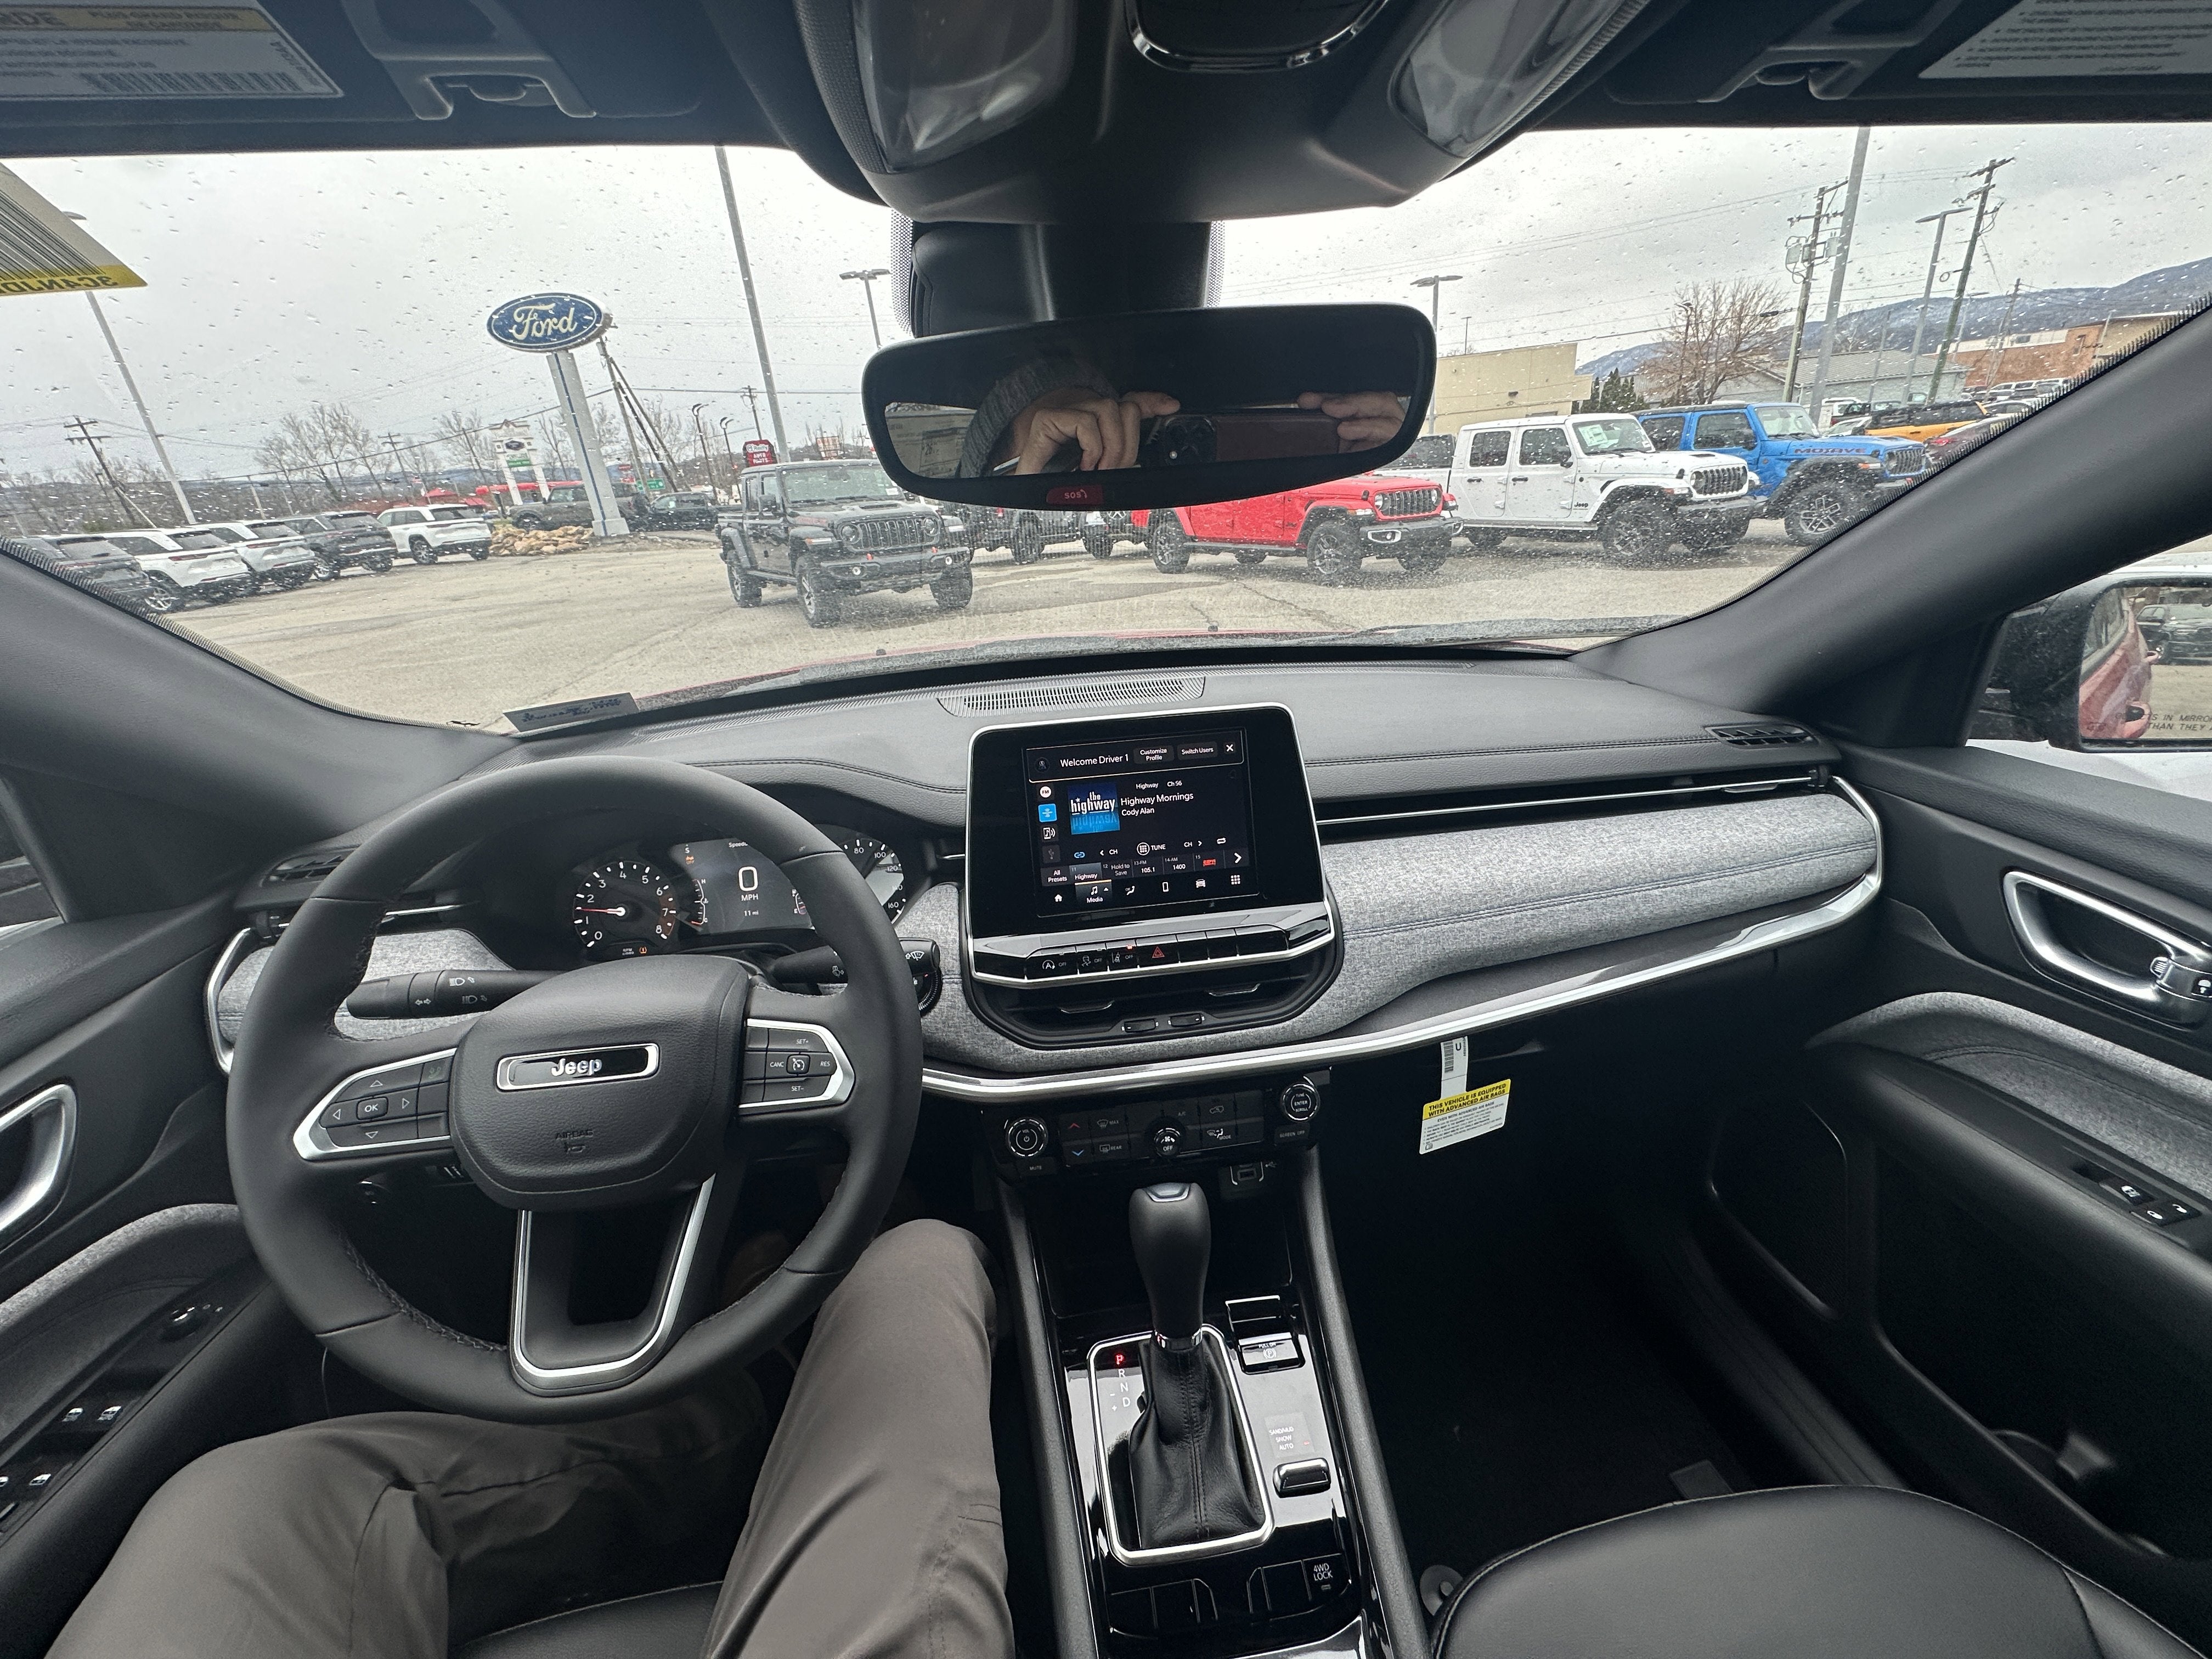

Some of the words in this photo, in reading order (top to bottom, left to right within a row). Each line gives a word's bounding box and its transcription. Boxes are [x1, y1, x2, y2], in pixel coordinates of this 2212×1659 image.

[512, 303, 578, 340] Ford
[2149, 722, 2174, 731] THAN
[2180, 723, 2206, 731] THEY
[1060, 757, 1098, 768] Welcome
[1098, 755, 1123, 765] Driver
[1125, 754, 1129, 762] 1
[1136, 782, 1159, 790] Highway
[1089, 791, 1101, 801] the
[1120, 797, 1155, 807] Highway
[1156, 792, 1194, 804] Mornings
[1070, 798, 1115, 815] highway
[1121, 808, 1139, 817] Cody
[619, 871, 627, 879] 4
[641, 875, 649, 884] 5
[738, 866, 759, 891] 0
[1074, 873, 1098, 881] Highway
[598, 879, 606, 888] 3
[656, 887, 663, 896] 6
[586, 894, 595, 903] 2
[741, 893, 759, 901] MPH
[662, 908, 669, 917] 7
[586, 916, 589, 924] 1
[655, 925, 662, 934] 8
[594, 931, 603, 940] 0
[1455, 1042, 1462, 1051] U
[551, 1058, 603, 1077] Jeep
[1444, 1096, 1470, 1107] VEHICLE
[1477, 1083, 1506, 1096] EQUIPPED
[1428, 1108, 1445, 1118] WITH
[1446, 1098, 1479, 1112] ADVANCED
[1490, 1088, 1506, 1098] BAGS
[364, 1103, 379, 1113] OK
[1458, 1107, 1478, 1116] ADVANCED
[555, 1128, 594, 1140] AIRBAG
[1115, 1355, 1124, 1365] P
[1118, 1368, 1126, 1378] R
[1120, 1382, 1129, 1392] N
[1122, 1397, 1131, 1408] D
[1276, 1435, 1293, 1443] SNOW
[1313, 1562, 1330, 1573] 4WD
[1313, 1570, 1334, 1581] LOCK
